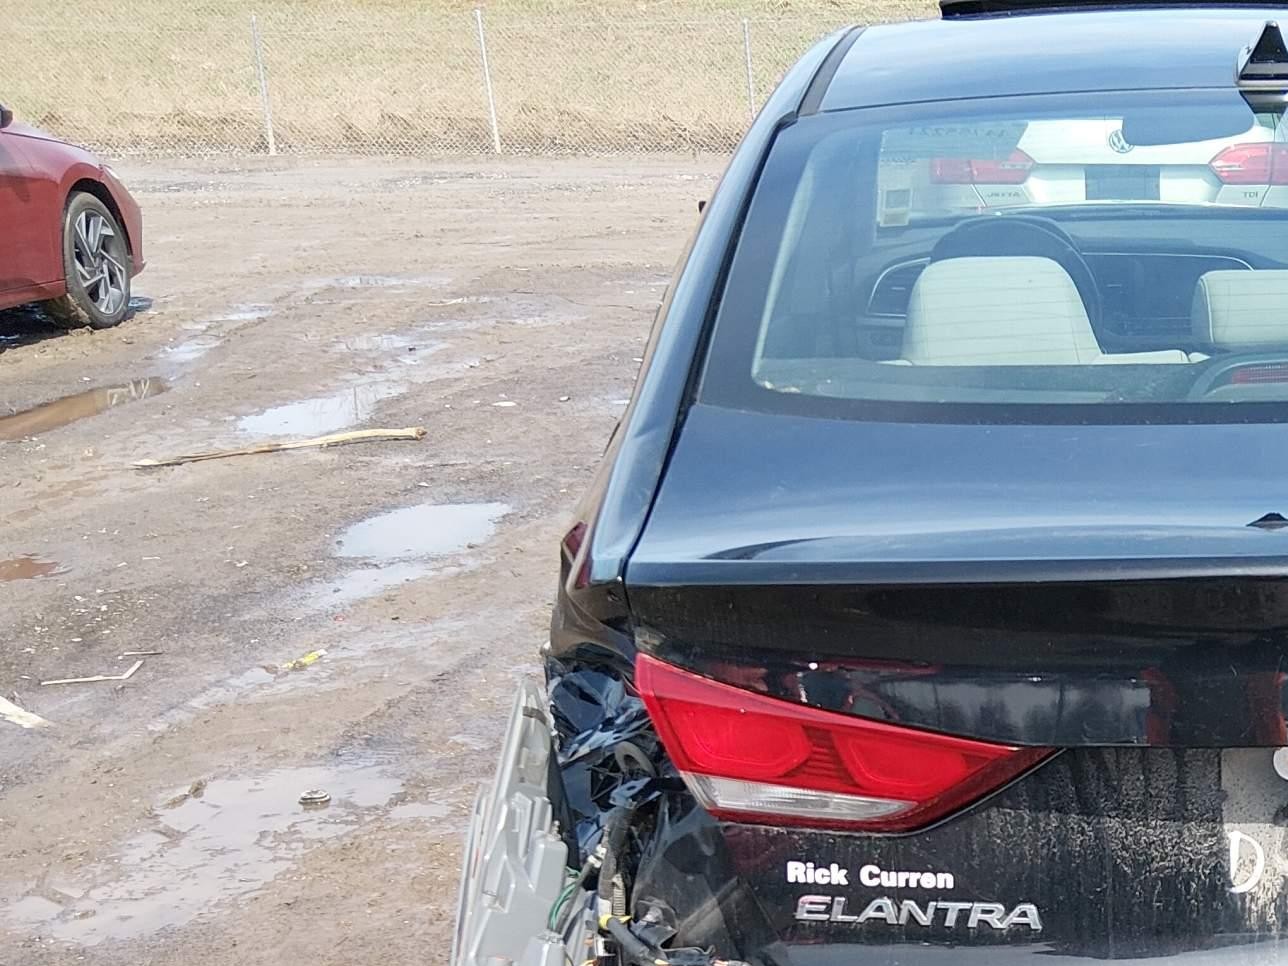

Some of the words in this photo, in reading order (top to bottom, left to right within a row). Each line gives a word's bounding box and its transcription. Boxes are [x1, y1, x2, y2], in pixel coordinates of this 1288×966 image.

[1243, 191, 1259, 199] TDI
[786, 861, 849, 886] Rick
[1228, 830, 1265, 893] D
[795, 895, 1042, 931] ELANTRA
